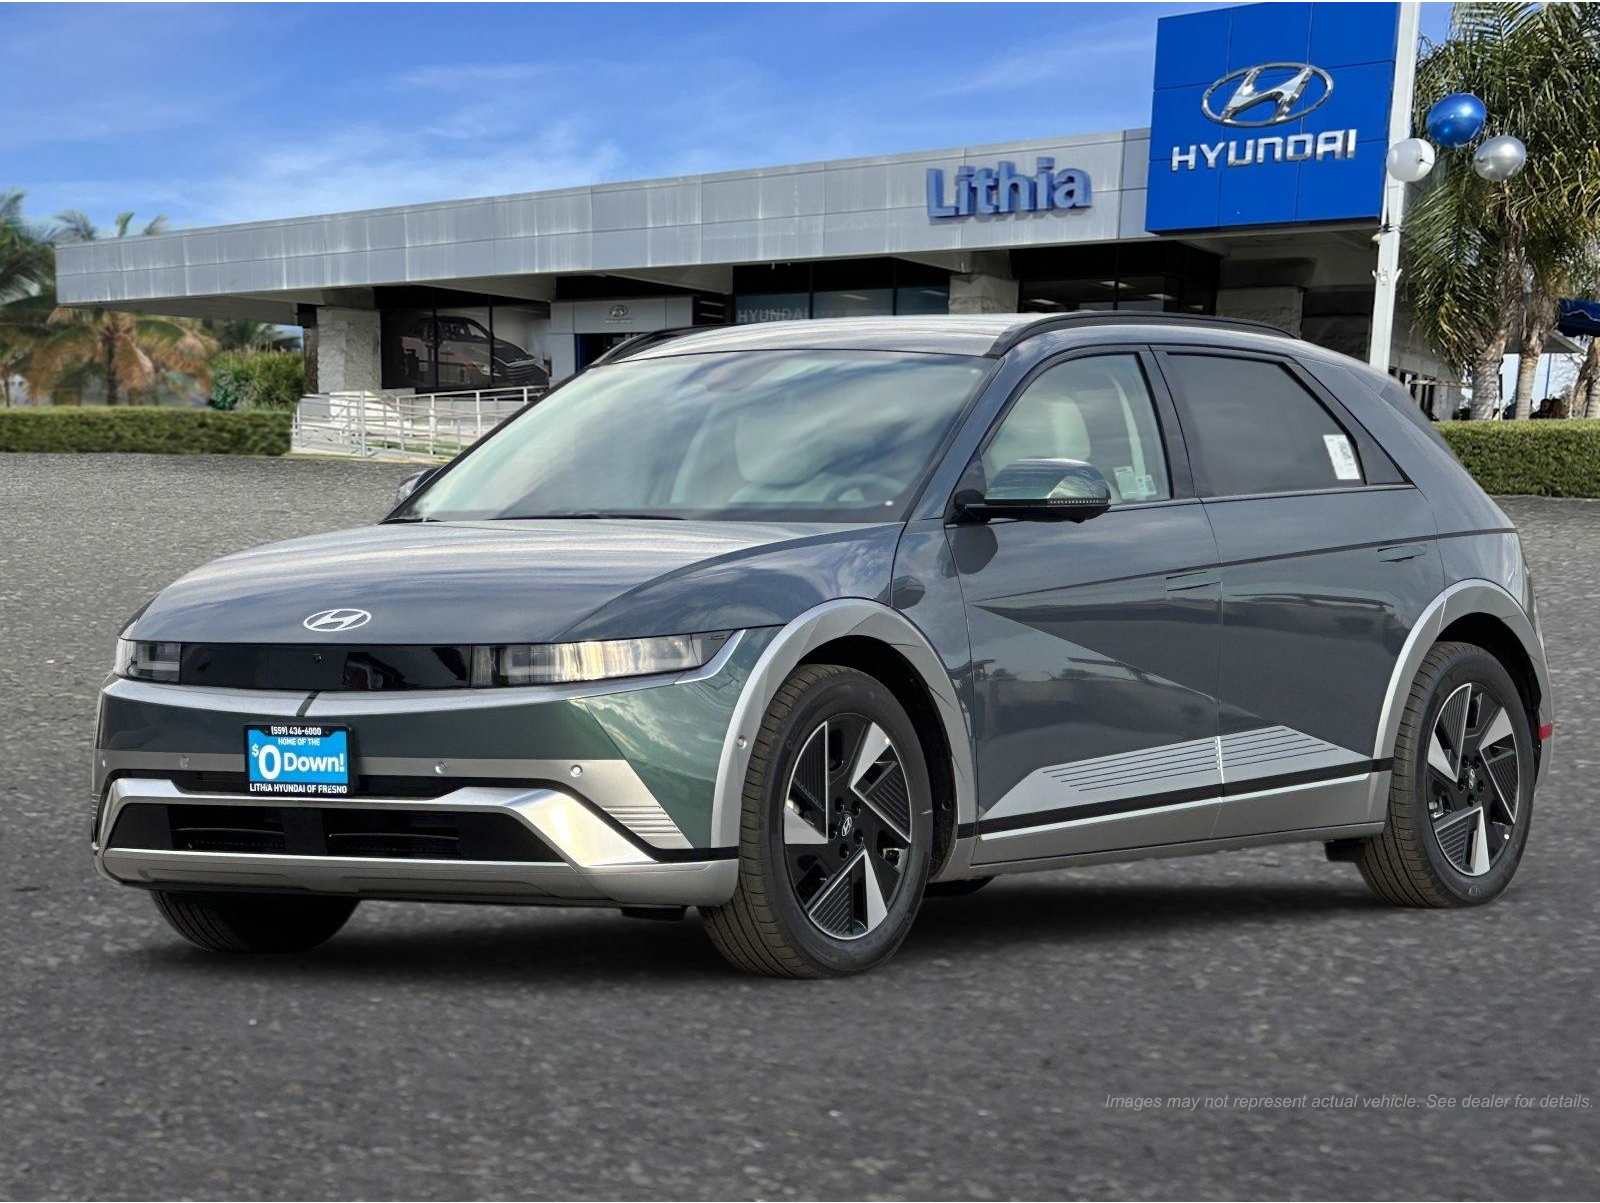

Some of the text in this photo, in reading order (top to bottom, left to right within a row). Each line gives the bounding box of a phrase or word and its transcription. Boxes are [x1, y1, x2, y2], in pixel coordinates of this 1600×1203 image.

[1170, 128, 1357, 172] HYUNDAI
[926, 157, 1092, 218] Lithia
[271, 726, 321, 735] (559) 436-6000
[278, 737, 296, 746] HOME
[308, 738, 320, 746] THE
[283, 752, 345, 772] Down!
[249, 783, 347, 794] LITHIA HYUNDAI OF FRESNO
